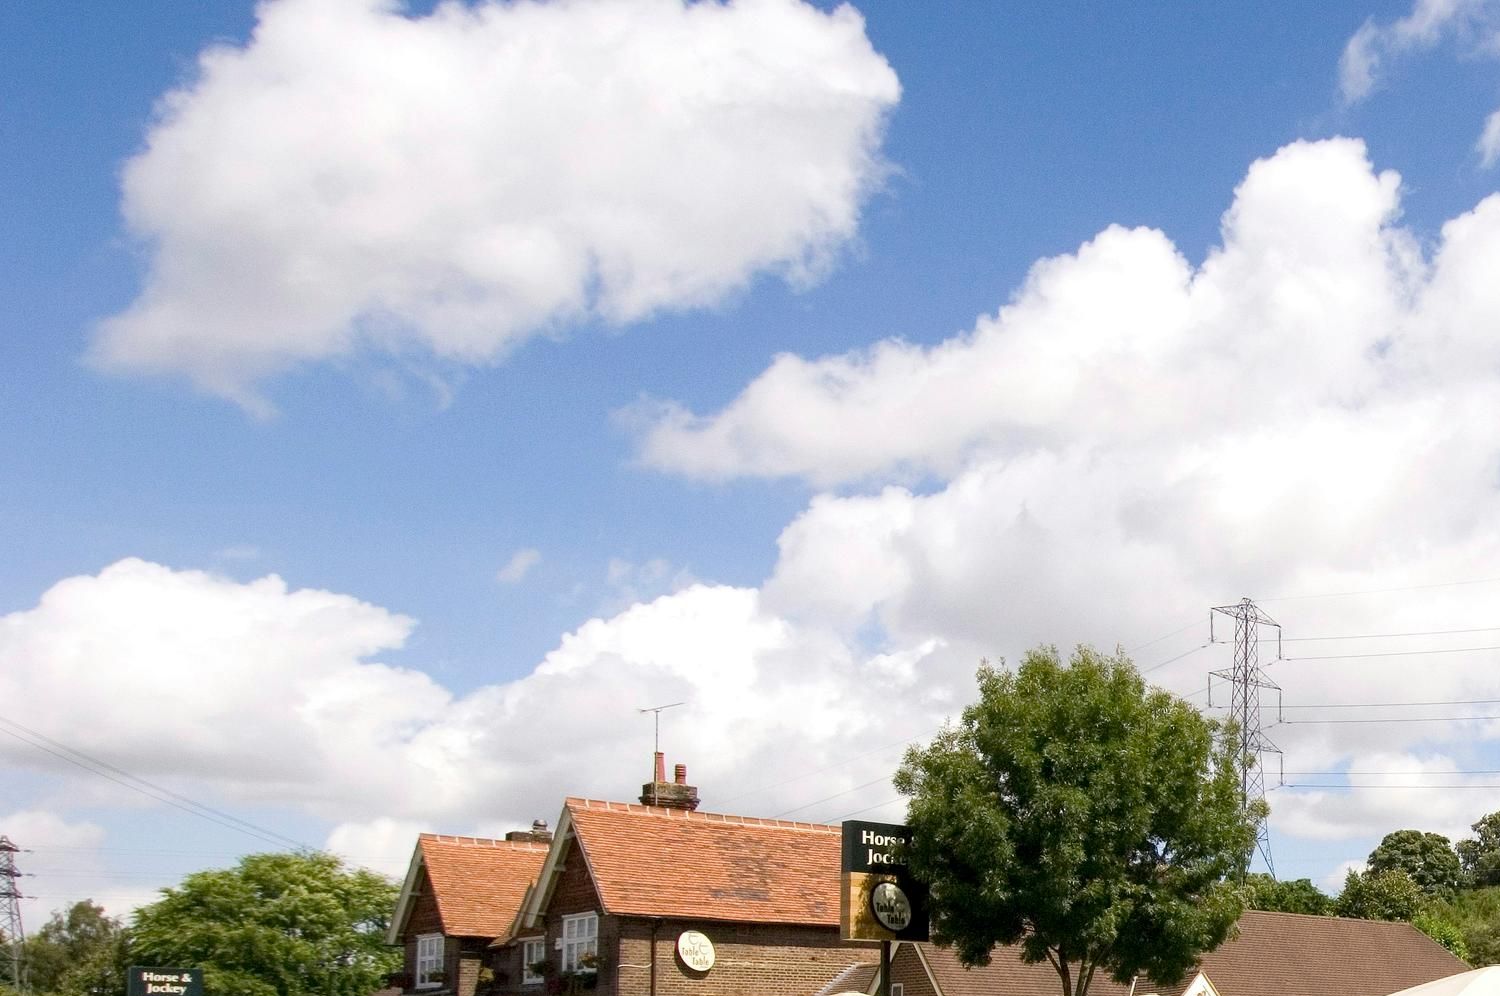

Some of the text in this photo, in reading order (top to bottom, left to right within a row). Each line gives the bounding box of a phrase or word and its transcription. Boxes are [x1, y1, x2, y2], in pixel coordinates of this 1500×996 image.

[682, 945, 699, 957] Table
[692, 955, 710, 966] Table
[142, 971, 192, 983] Horse &
[146, 983, 187, 996] Jockey
